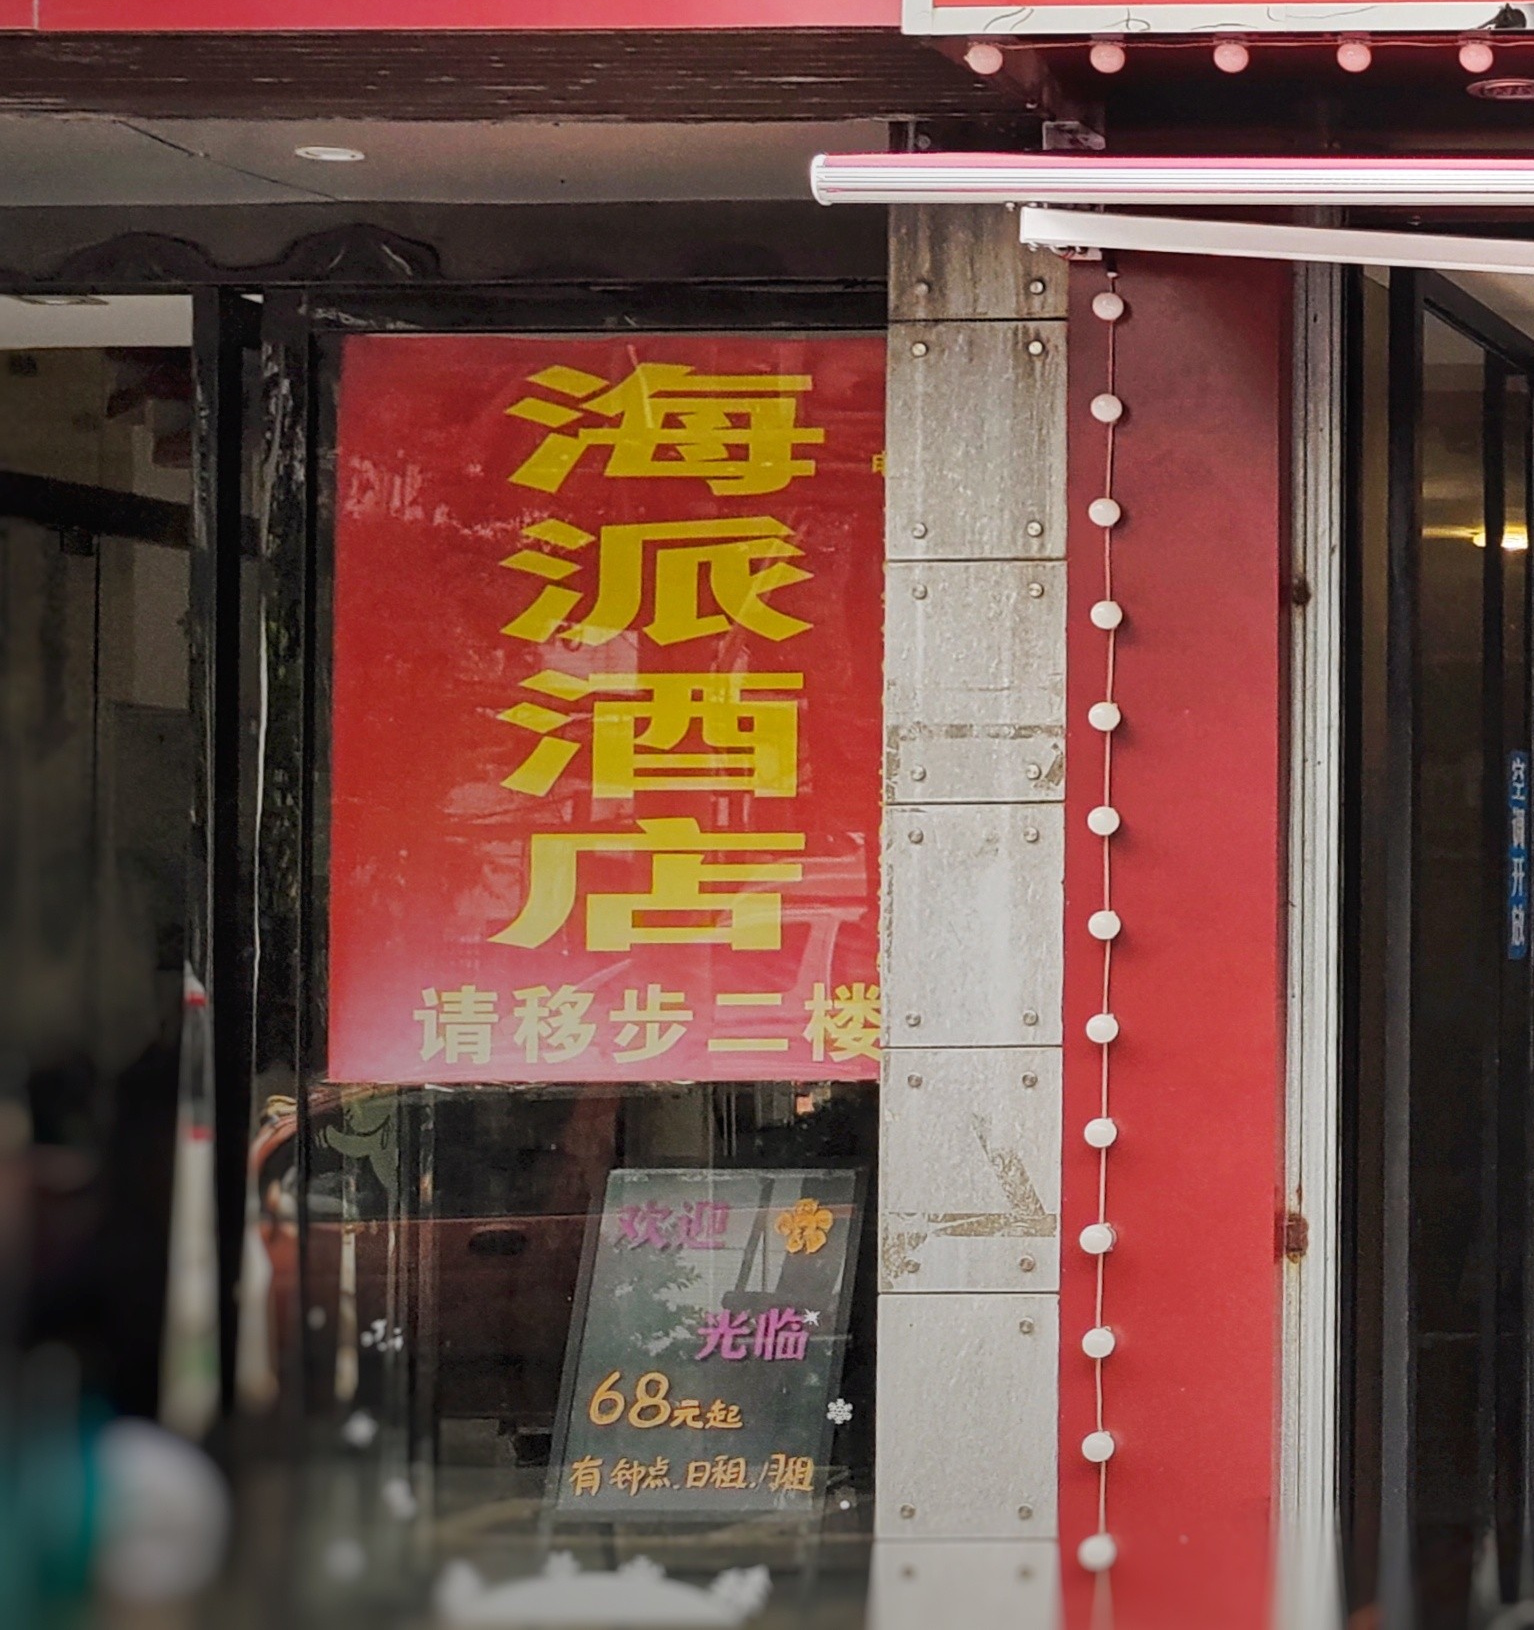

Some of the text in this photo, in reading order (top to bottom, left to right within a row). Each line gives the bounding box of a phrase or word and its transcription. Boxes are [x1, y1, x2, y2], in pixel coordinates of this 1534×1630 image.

[487, 362, 824, 952] 海派酒店
[413, 982, 885, 1065] 请移步二楼
[614, 1199, 732, 1251] 欢迎
[695, 1307, 812, 1362] 光临
[587, 1369, 745, 1431] 68元起
